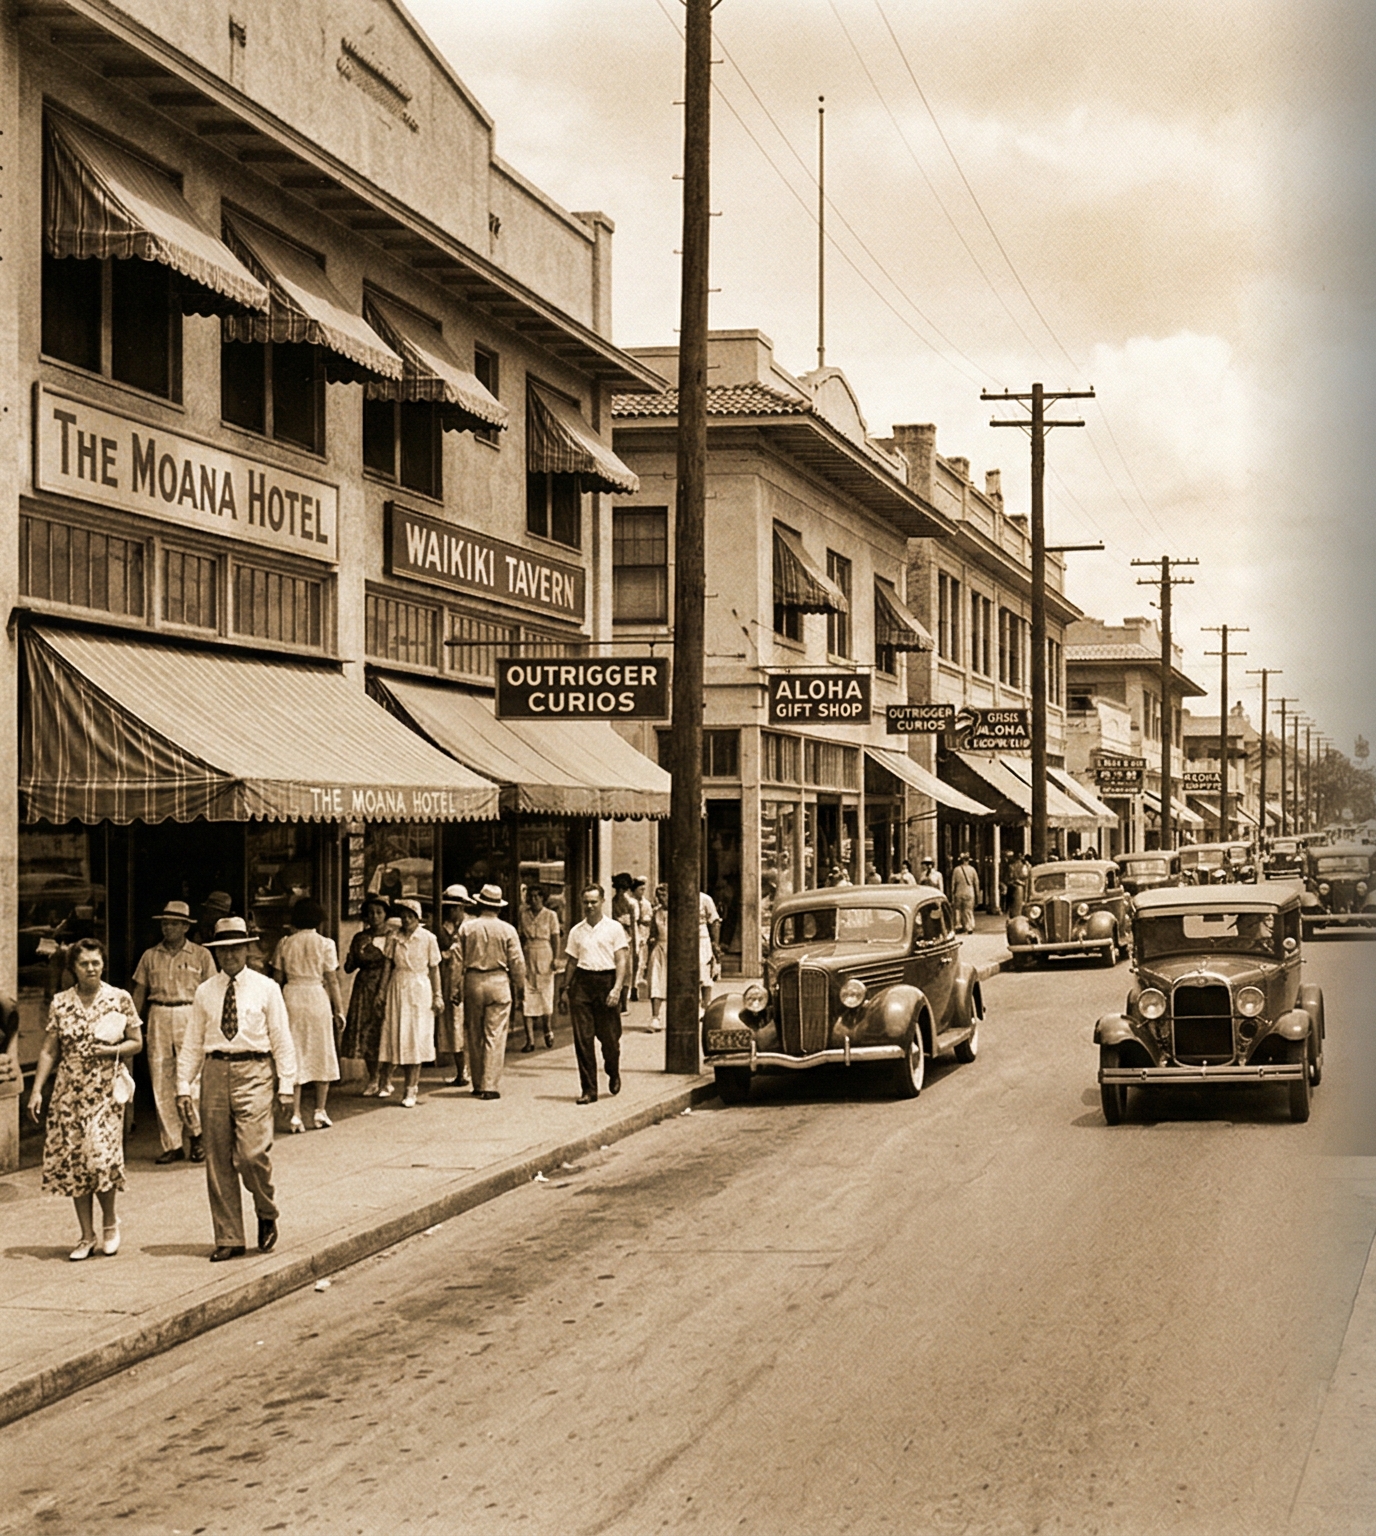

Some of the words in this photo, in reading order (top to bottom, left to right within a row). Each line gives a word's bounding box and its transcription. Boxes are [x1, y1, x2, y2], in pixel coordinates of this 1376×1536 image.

[54, 408, 118, 488] THE
[131, 432, 238, 520] MOANA
[247, 469, 329, 545] HOTEL
[405, 521, 496, 587] WAIKIKI
[505, 555, 575, 610] TAVERN
[507, 665, 658, 686] OUTRIGGER
[775, 680, 862, 700] ALOHA
[529, 691, 635, 712] CURIOS
[776, 704, 811, 718] GIFT
[818, 703, 862, 717] SHOP
[889, 708, 952, 719] OUTRIGGER
[897, 720, 946, 731] CURIOS
[309, 788, 343, 812] THE
[351, 790, 406, 813] MOANA
[413, 791, 457, 814] HOTEL
